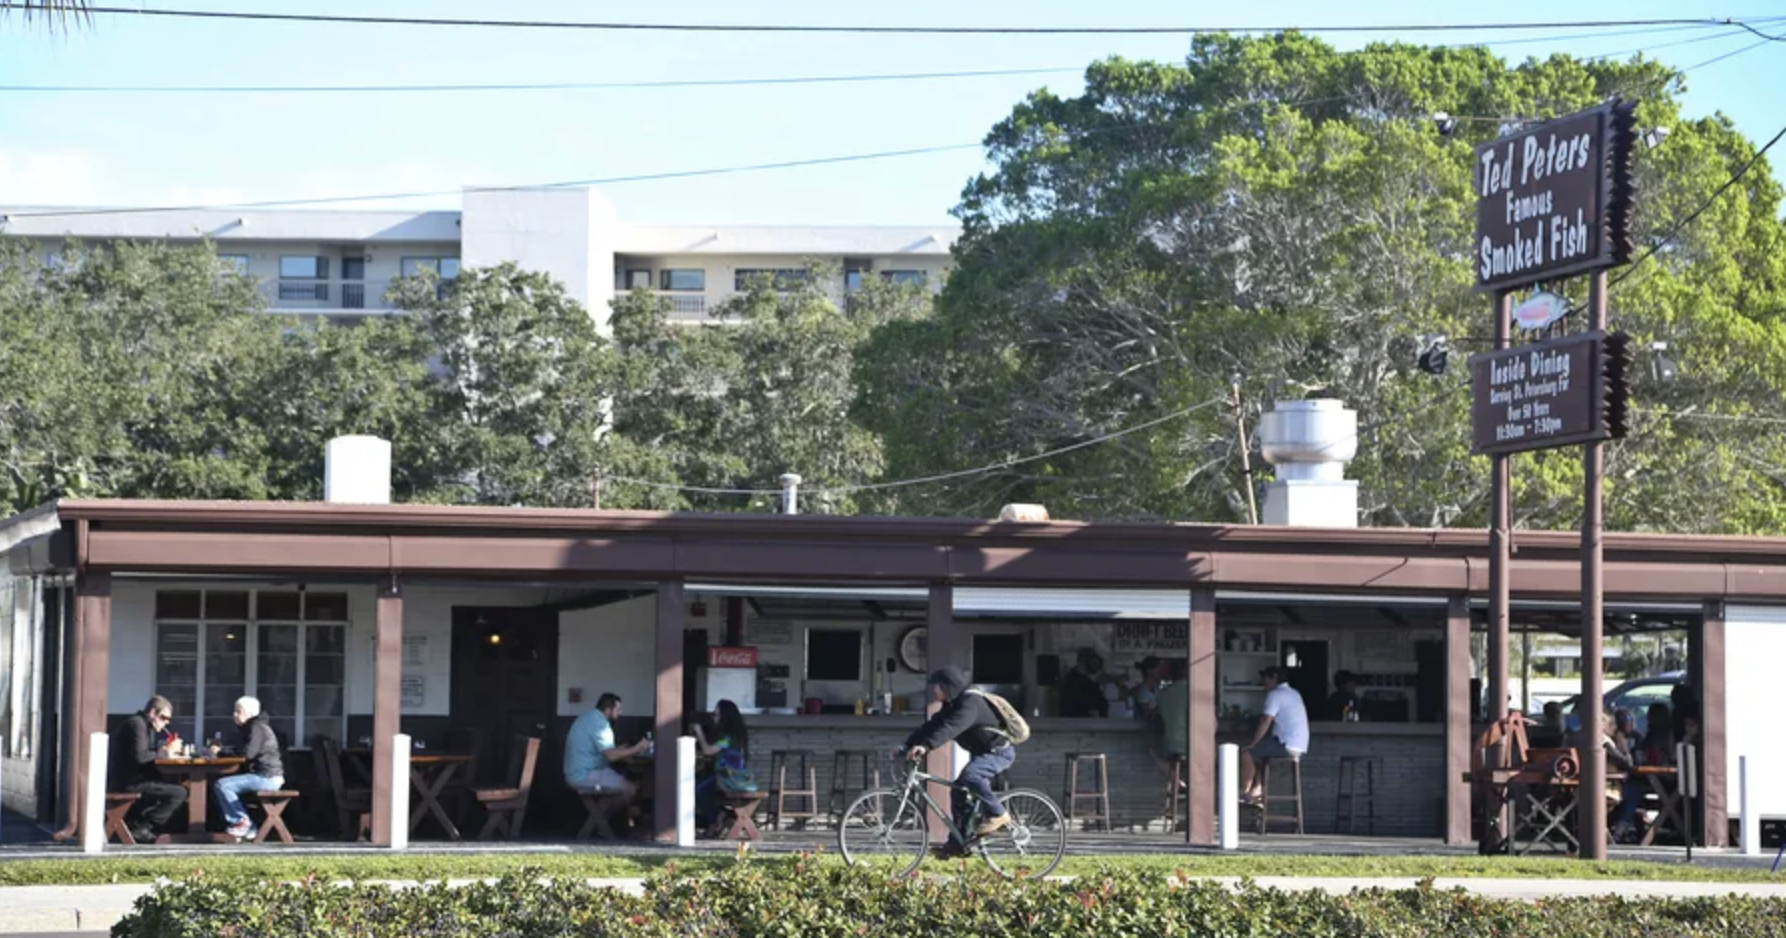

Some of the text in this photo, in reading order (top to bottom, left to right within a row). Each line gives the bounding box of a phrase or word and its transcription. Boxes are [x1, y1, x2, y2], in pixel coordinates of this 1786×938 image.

[1481, 133, 1590, 197] Ted Peters
[1506, 190, 1553, 224] Famous
[1480, 207, 1588, 280] Smoked Fish
[1490, 349, 1570, 385] Inside Dining
[1164, 623, 1188, 639] BEE
